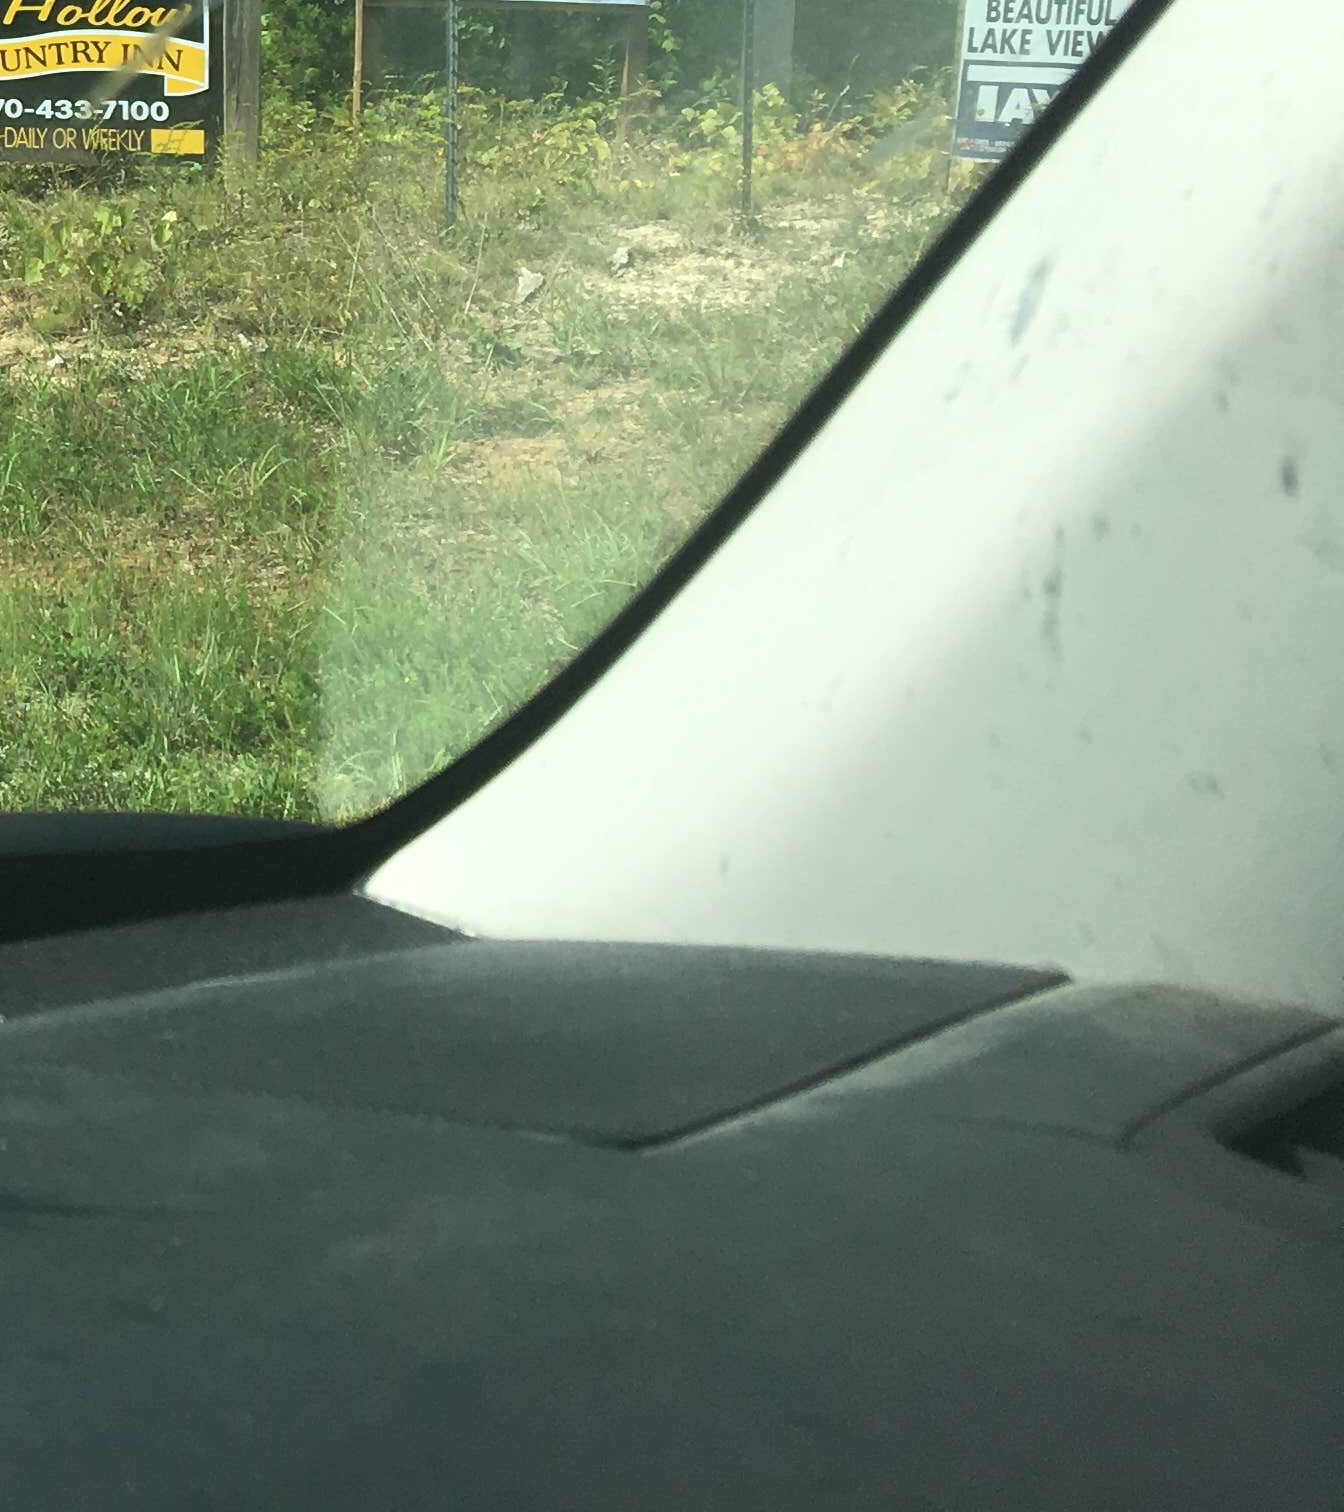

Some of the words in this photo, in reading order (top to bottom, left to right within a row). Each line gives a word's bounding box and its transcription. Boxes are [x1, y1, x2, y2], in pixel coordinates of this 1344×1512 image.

[967, 26, 1032, 56] LAKE
[4, 126, 48, 149] DAILY
[52, 128, 77, 149] OR
